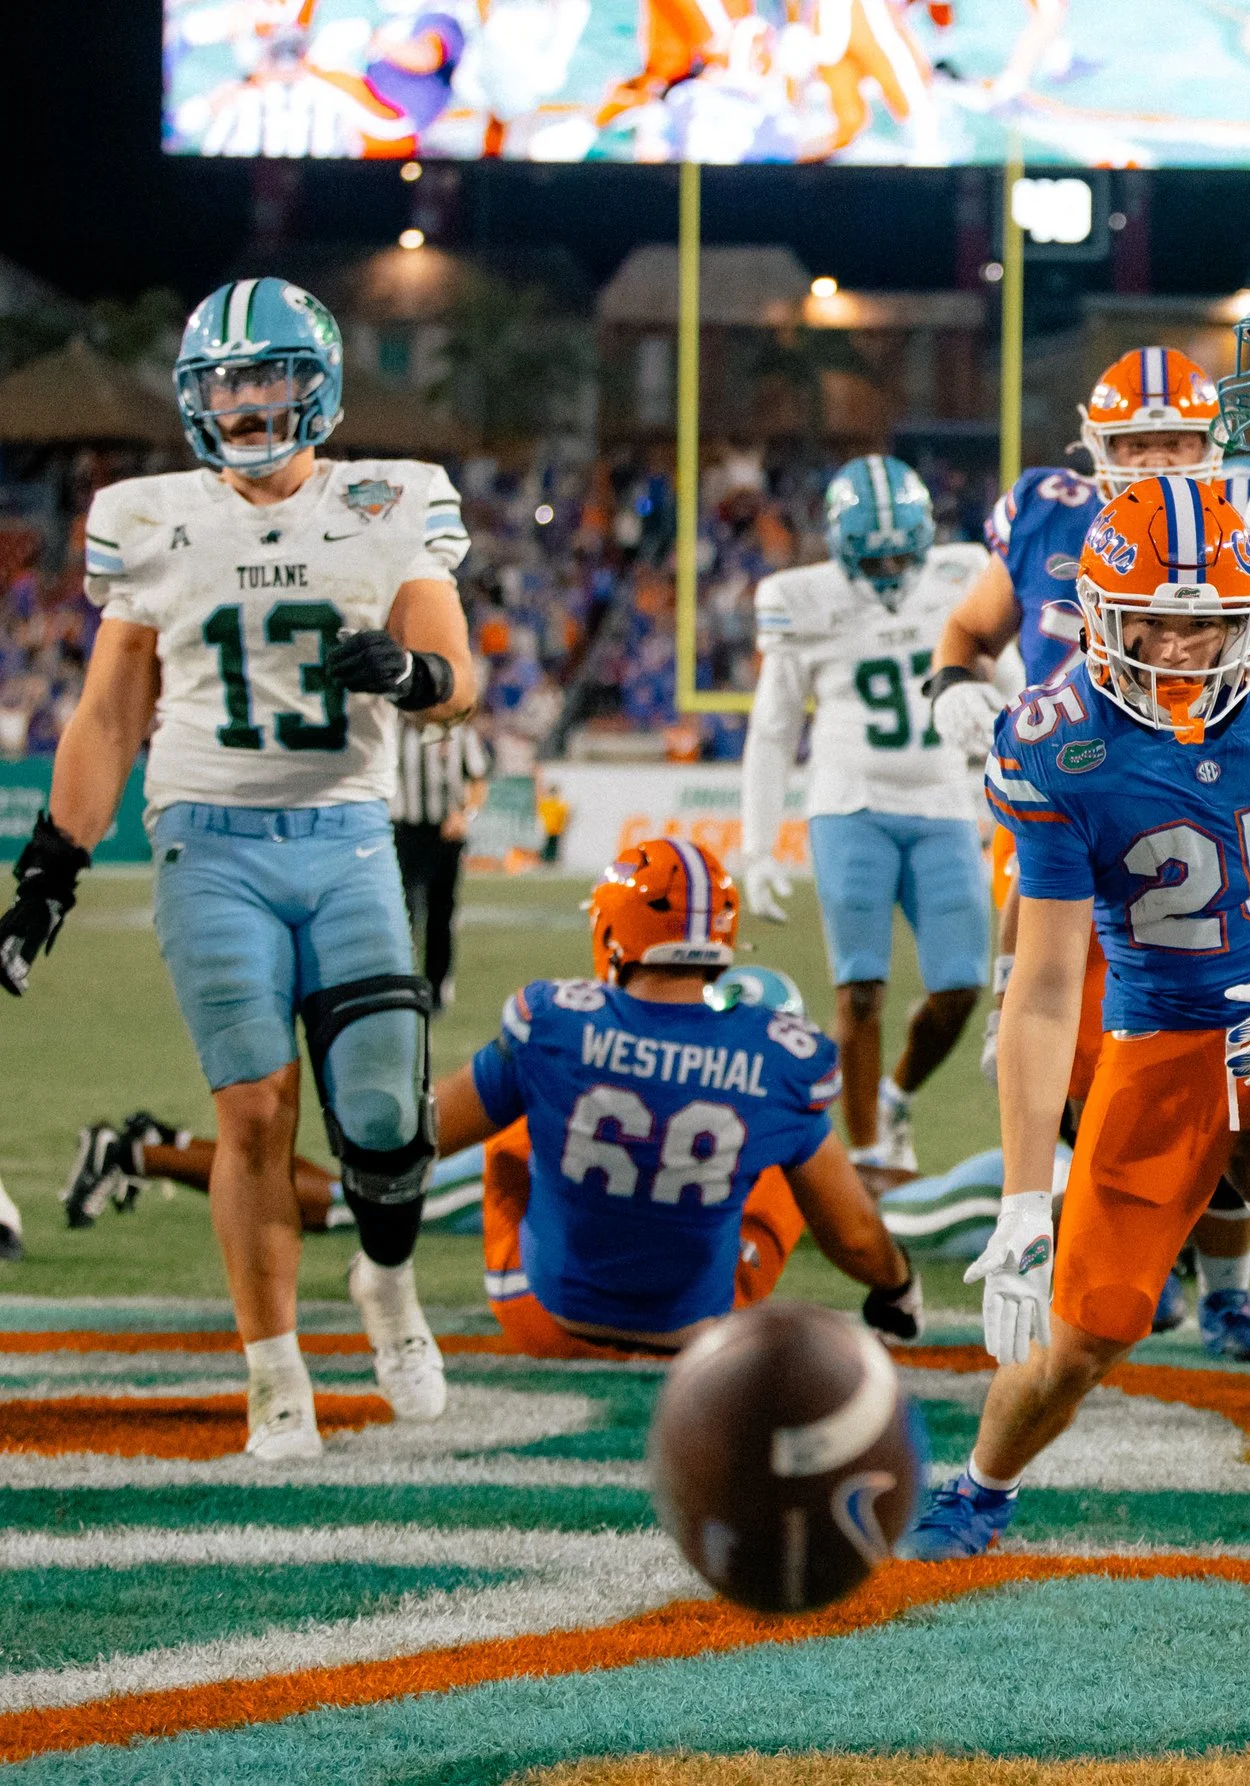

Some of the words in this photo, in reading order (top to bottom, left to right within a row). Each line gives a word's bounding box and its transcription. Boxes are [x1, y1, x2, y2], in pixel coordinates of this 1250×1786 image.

[236, 563, 309, 590] TULANE
[202, 601, 348, 751] 13
[581, 1023, 768, 1097] WESTPHAL
[560, 1085, 748, 1206] 68
